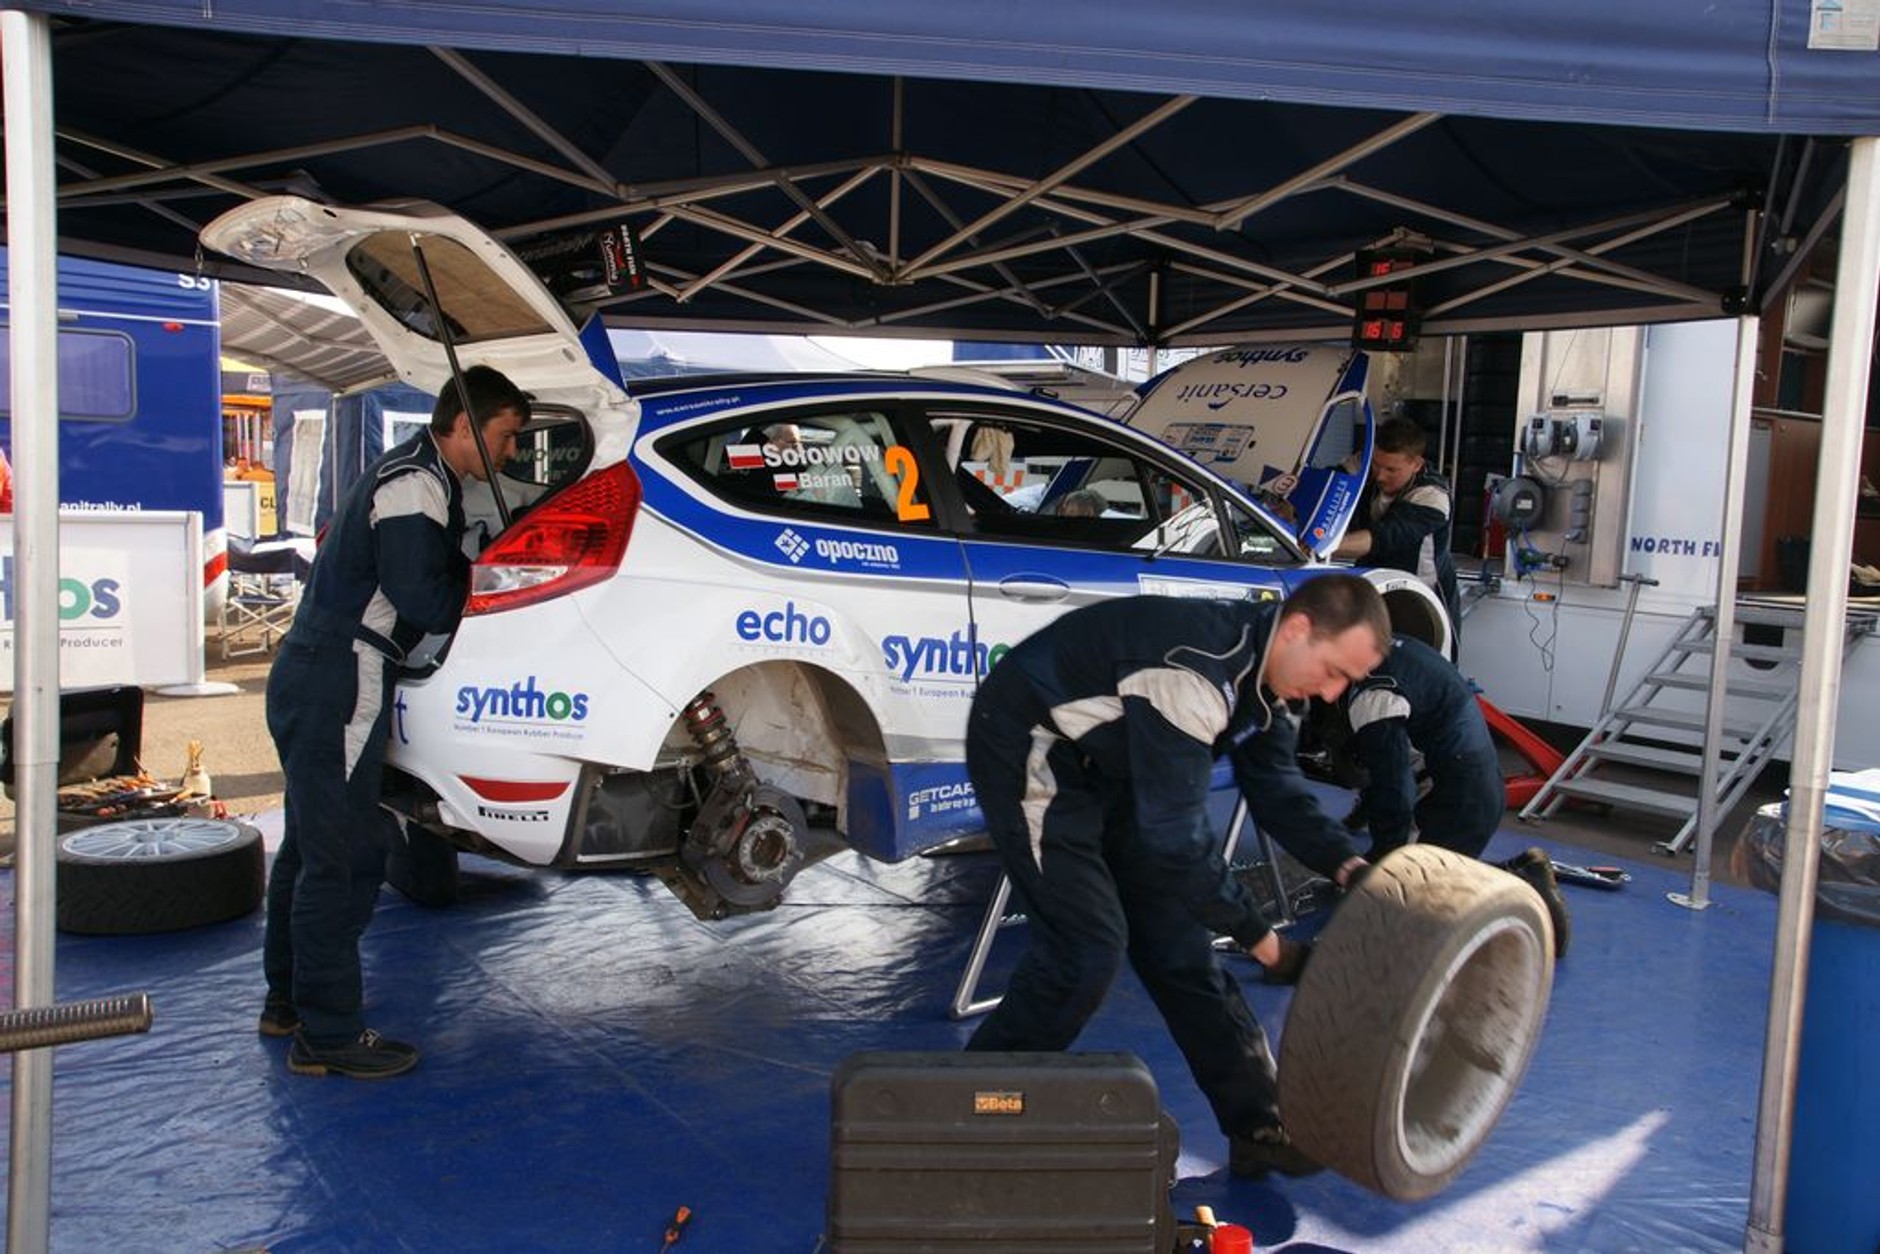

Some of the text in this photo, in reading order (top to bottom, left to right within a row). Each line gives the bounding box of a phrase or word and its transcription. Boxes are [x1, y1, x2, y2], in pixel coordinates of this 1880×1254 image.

[1177, 383, 1288, 402] cersanit
[799, 472, 853, 489] Baran
[885, 445, 931, 522] 2
[816, 538, 899, 563] opoczno
[1631, 537, 1696, 556] NORTH
[736, 601, 831, 645] echo
[456, 676, 589, 722] synthos
